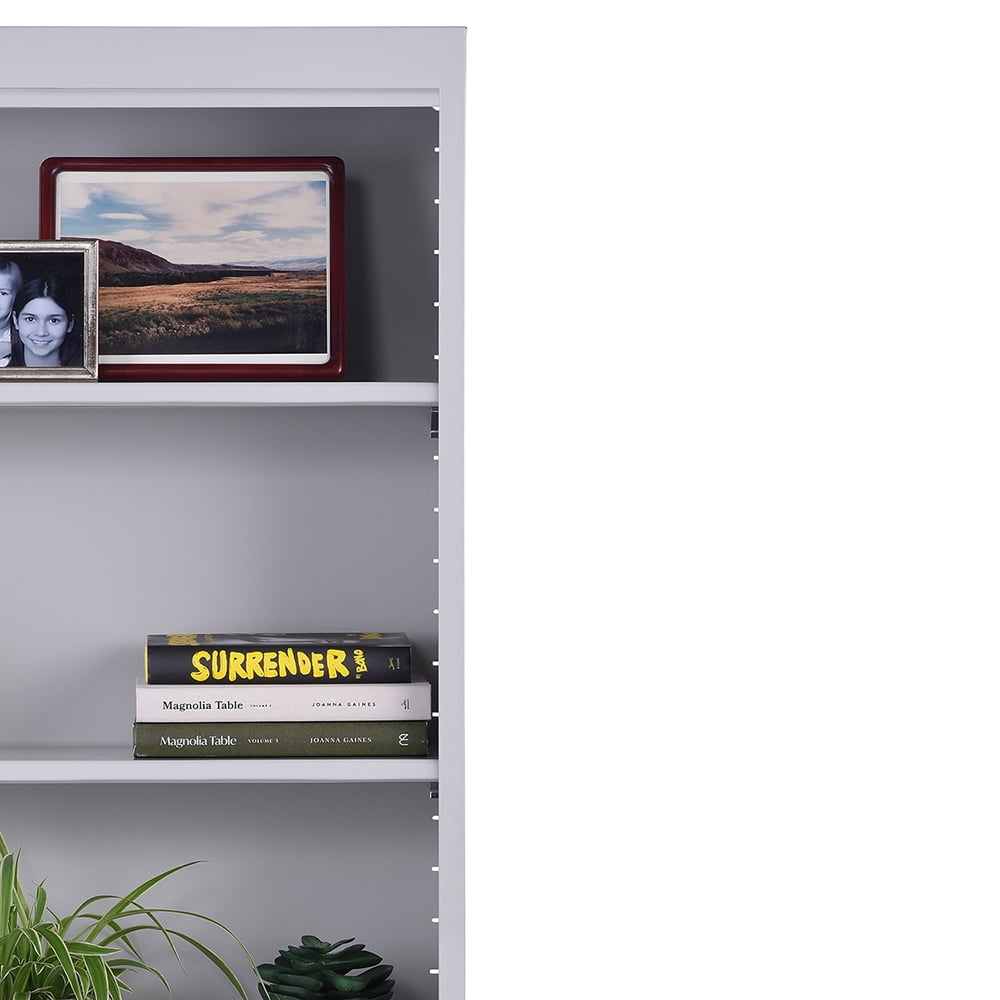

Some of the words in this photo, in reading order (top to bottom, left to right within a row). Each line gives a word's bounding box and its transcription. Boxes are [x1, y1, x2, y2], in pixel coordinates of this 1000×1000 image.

[190, 647, 350, 682] SURRENDER
[162, 701, 212, 712] Magnolia
[215, 701, 244, 710] Table
[160, 736, 208, 748] Magnolia
[209, 736, 238, 746] Table
